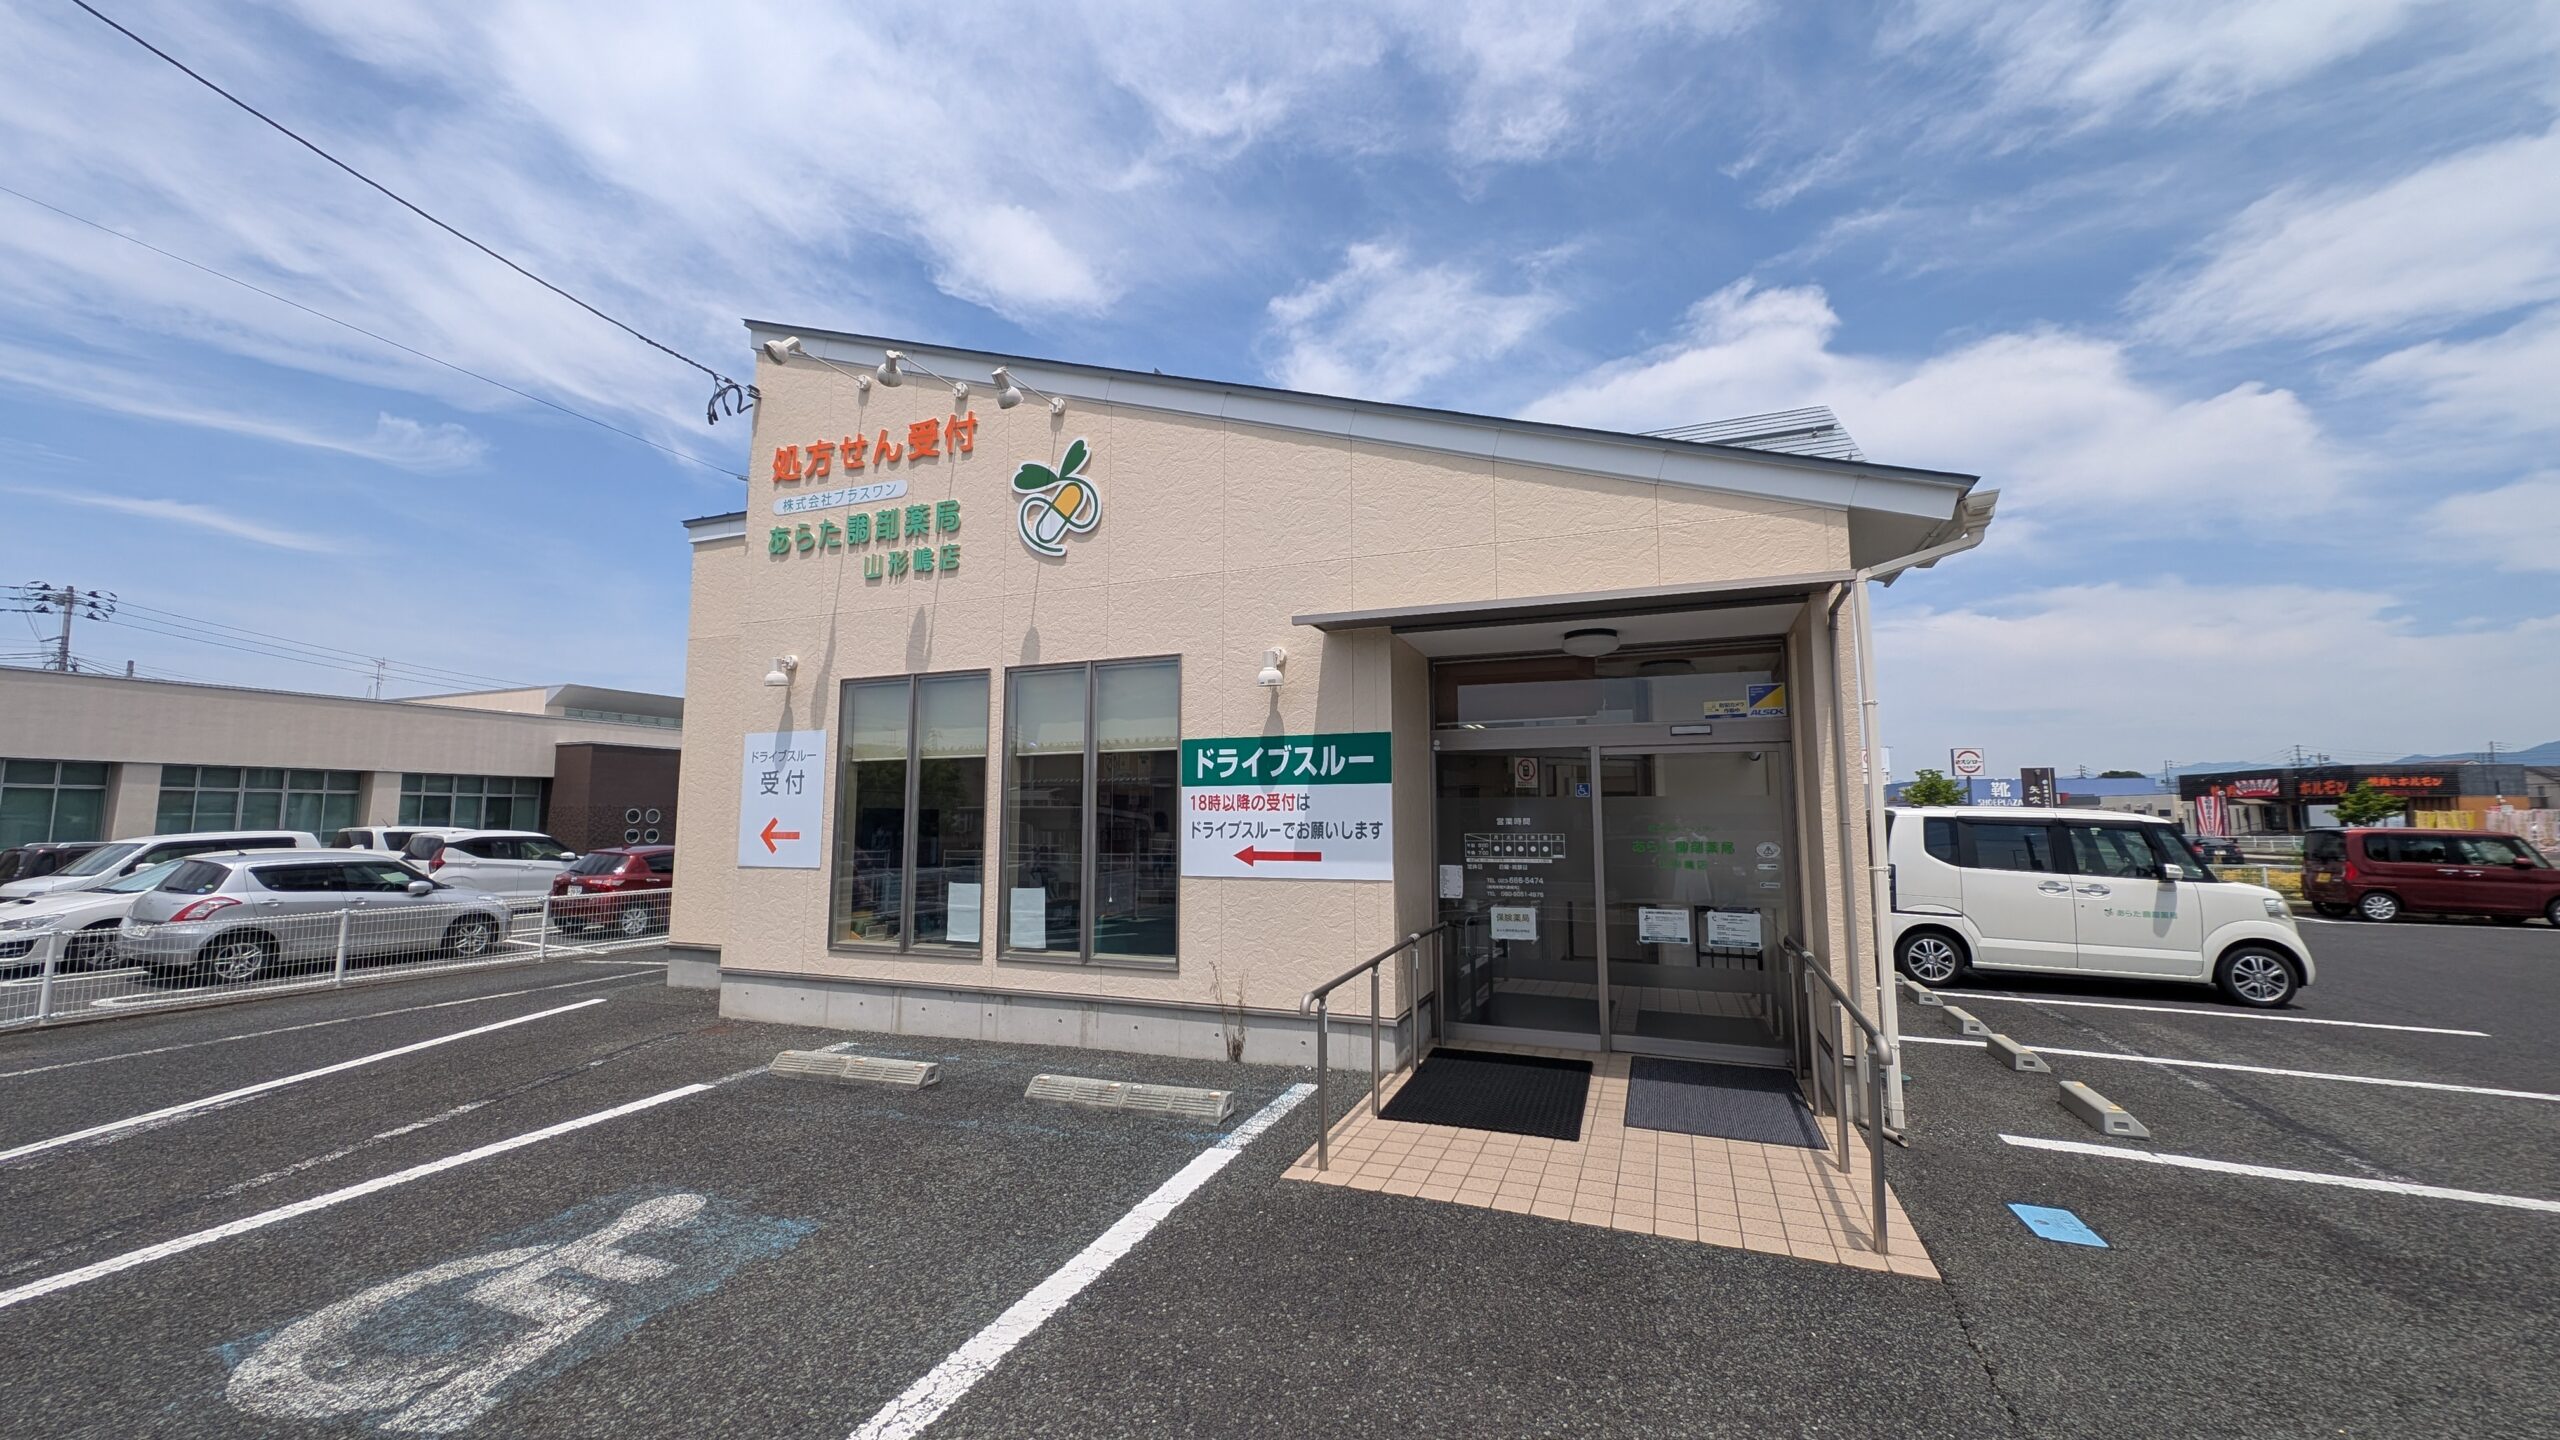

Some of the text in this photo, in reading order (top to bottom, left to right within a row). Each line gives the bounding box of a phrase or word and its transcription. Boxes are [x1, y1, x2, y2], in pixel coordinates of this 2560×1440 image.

[772, 410, 978, 482] 処方せん受付
[783, 483, 897, 512] 株式会社プラスワン
[768, 499, 961, 556] あらた調剤薬局
[864, 544, 961, 580] 山形嶋店
[1750, 708, 1784, 716] ALSOK
[751, 749, 817, 764] ドライブスルー
[1196, 744, 1375, 780] ドライブスルー
[760, 769, 805, 796] 受付
[1990, 782, 2011, 797] 靴
[2298, 779, 2349, 796] ホルモン
[1190, 792, 1311, 812] 18時以降の受付は
[2028, 785, 2042, 804] 矢吹
[1190, 820, 1384, 841] ドライブスルーでお願いします
